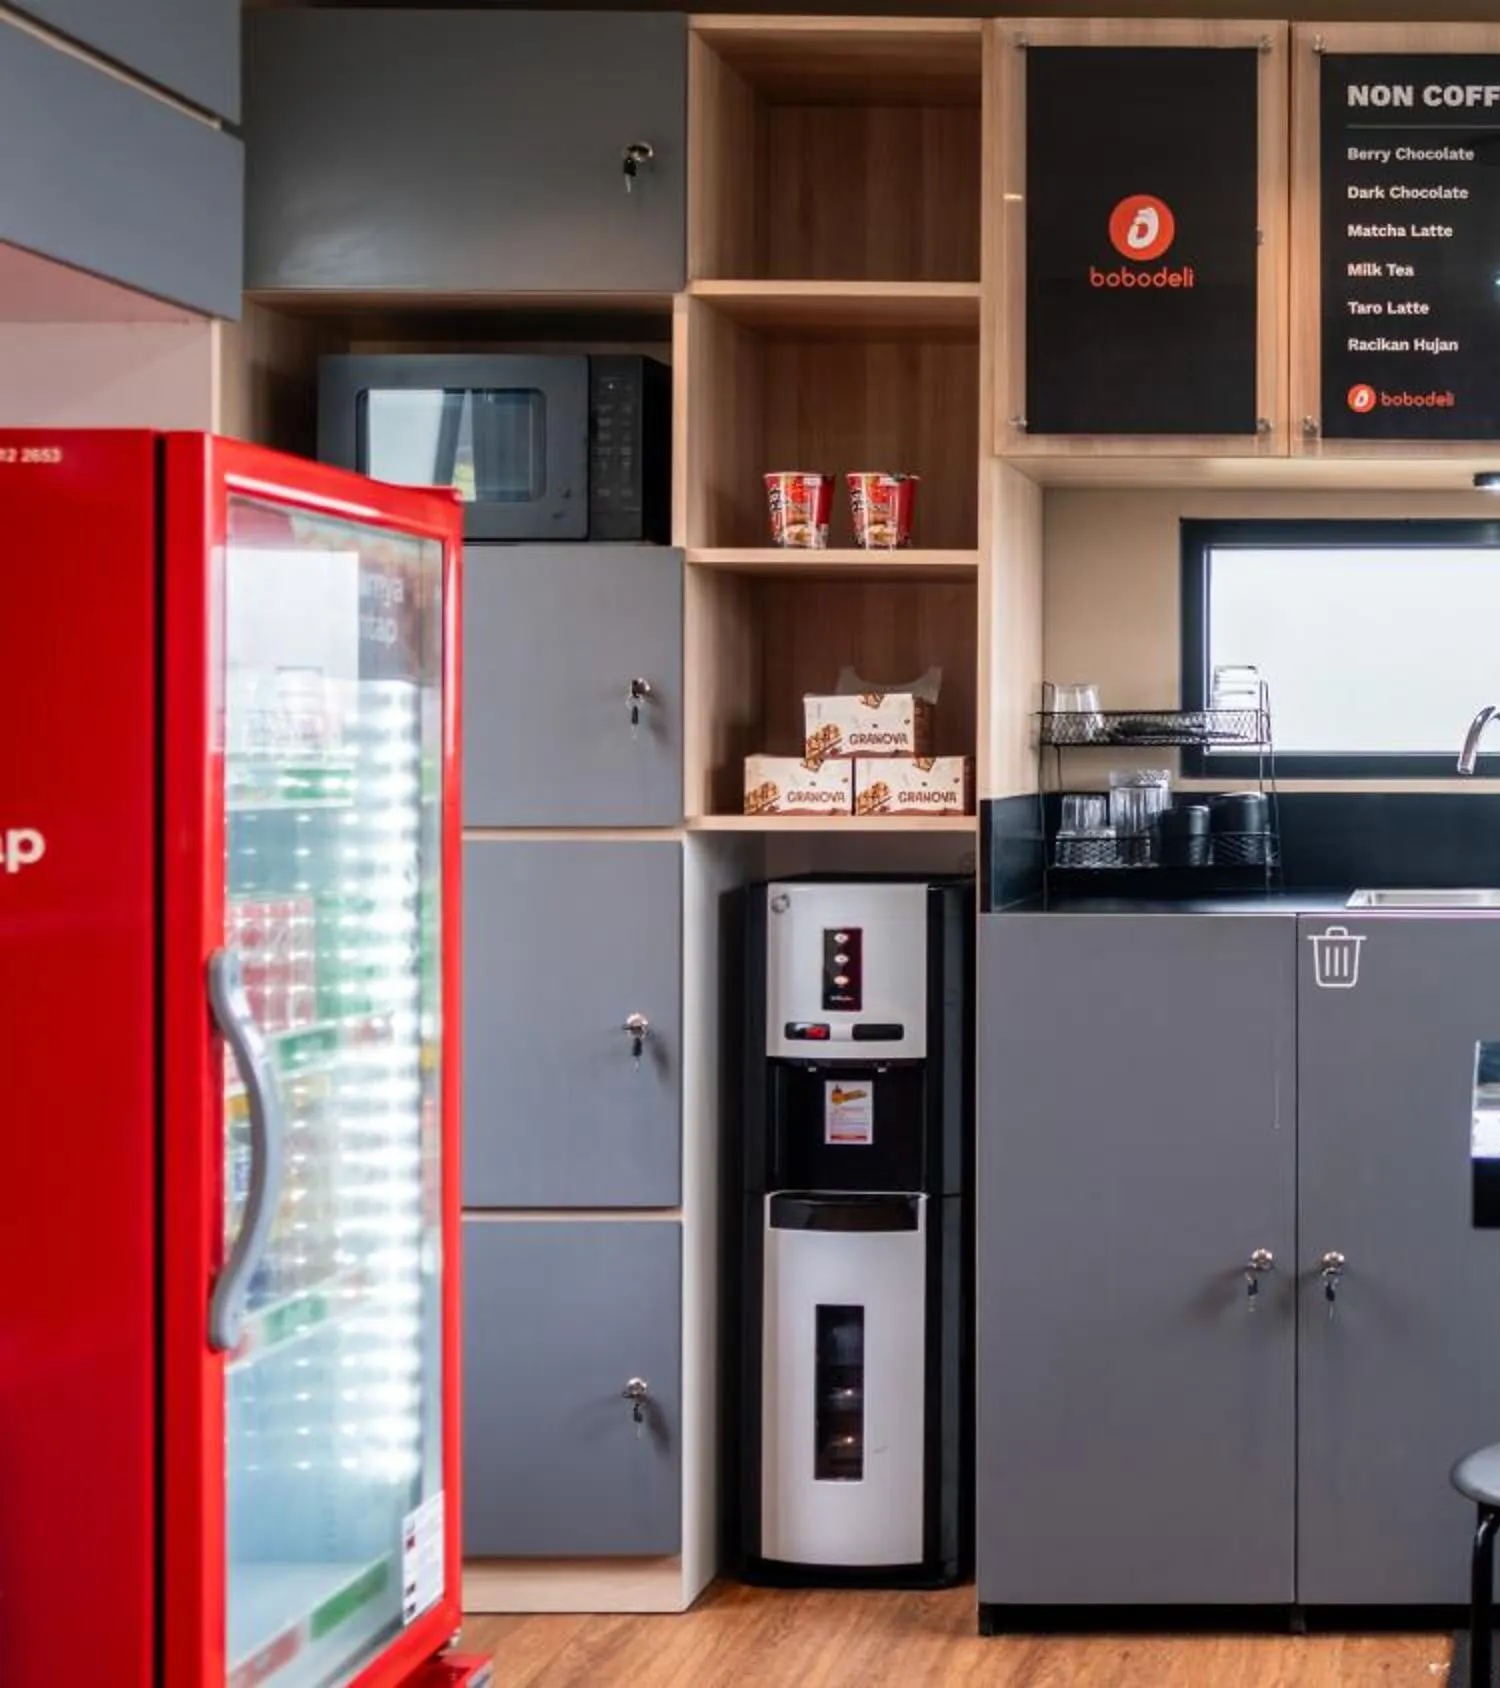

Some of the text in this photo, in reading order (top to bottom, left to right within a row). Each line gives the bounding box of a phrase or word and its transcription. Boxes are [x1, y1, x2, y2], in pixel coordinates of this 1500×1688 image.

[1347, 85, 1413, 107] NON
[1347, 147, 1391, 163] Berry
[1395, 147, 1475, 161] Chocolate
[1347, 186, 1385, 199] Dark
[1389, 185, 1469, 199] Chocolate
[1347, 224, 1406, 237] Matcha
[1411, 224, 1453, 237] Latte
[1347, 262, 1382, 276] Milk
[1386, 263, 1414, 276] Tea
[1089, 266, 1194, 288] bobodeli
[1347, 301, 1382, 314] Taro
[1387, 301, 1429, 314] Latte
[1347, 338, 1409, 351] Racikan
[1413, 337, 1459, 354] Hujan
[1381, 391, 1455, 406] bobodeli
[850, 732, 909, 745] GRANOVA
[787, 791, 845, 803] GRANOVA
[898, 791, 957, 803] GRANOVA
[0, 827, 46, 873] p
